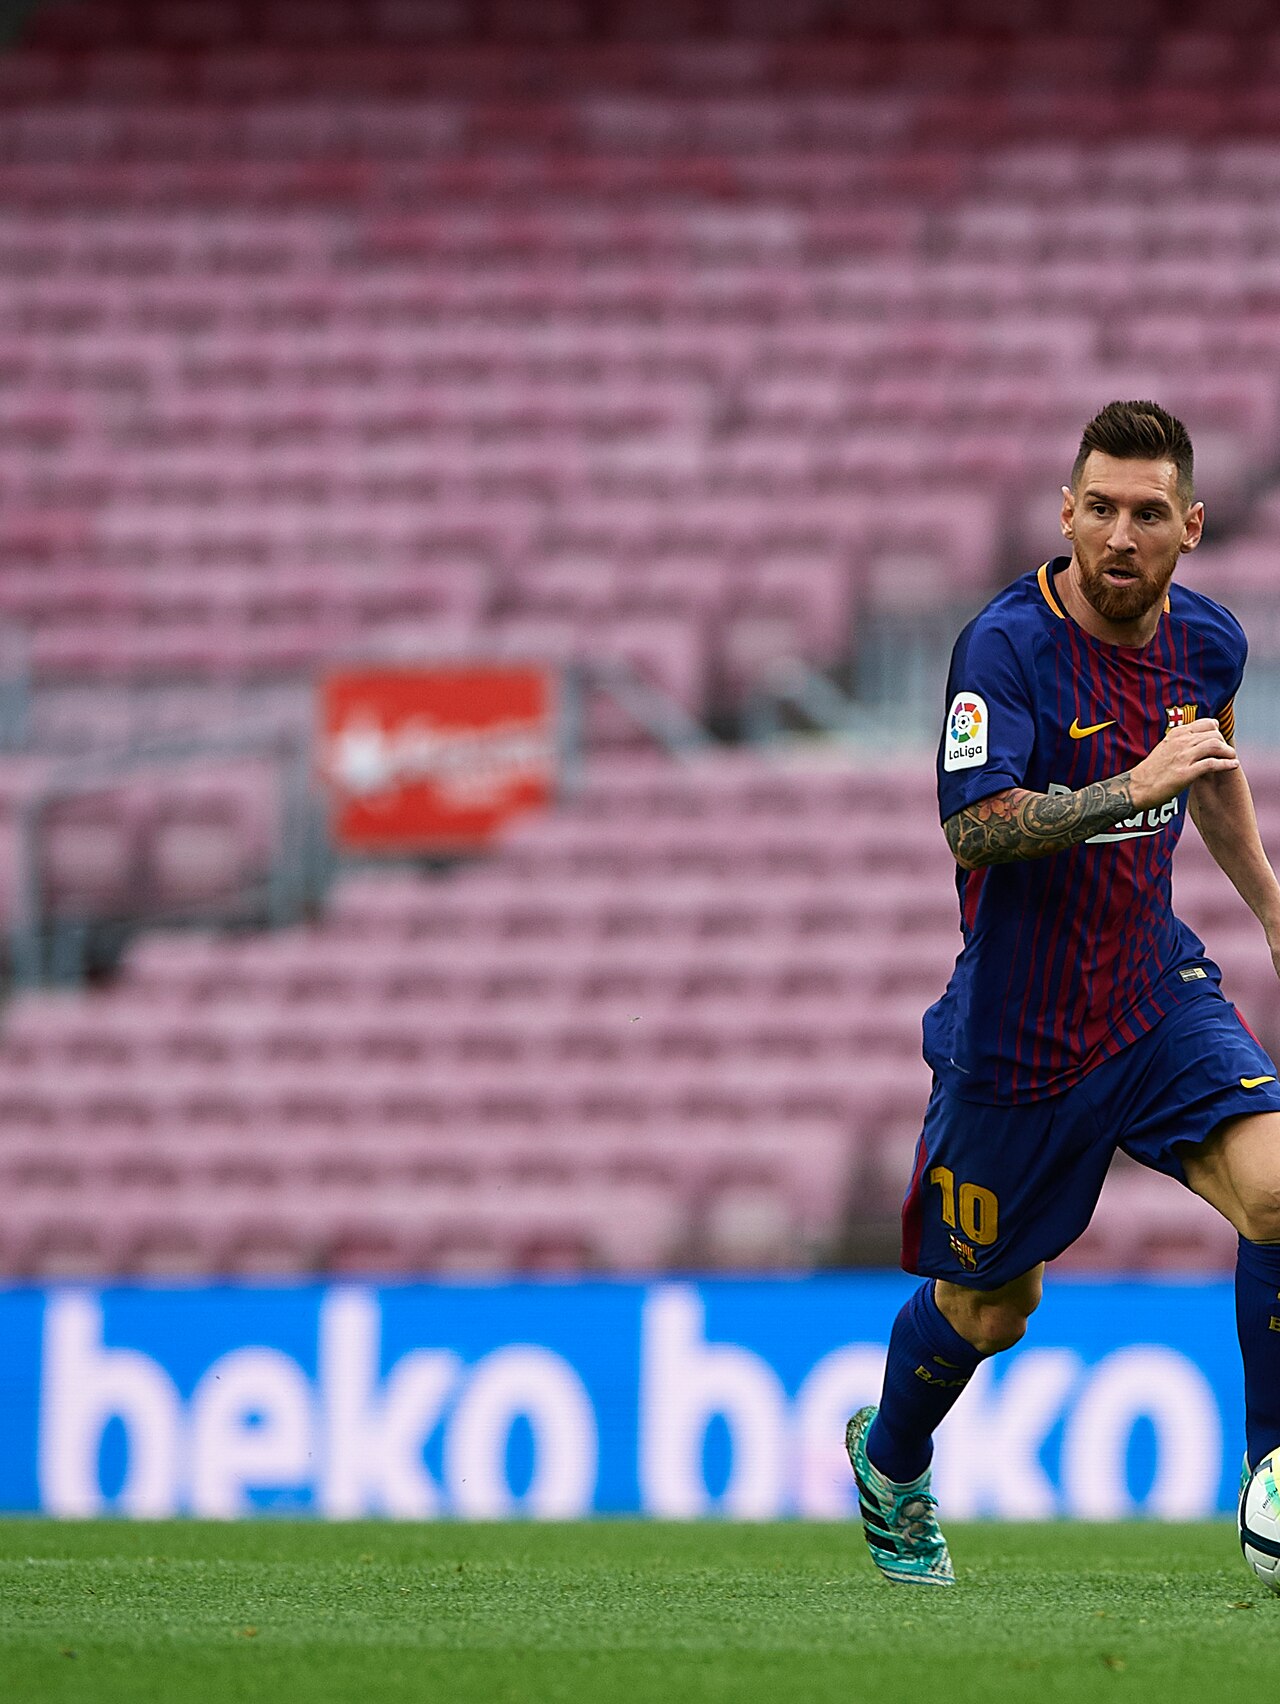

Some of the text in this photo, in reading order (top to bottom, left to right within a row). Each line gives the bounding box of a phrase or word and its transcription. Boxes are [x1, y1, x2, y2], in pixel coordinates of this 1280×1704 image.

[949, 745, 982, 760] LaLiga
[930, 1166, 999, 1245] 10
[39, 1286, 599, 1521] beko
